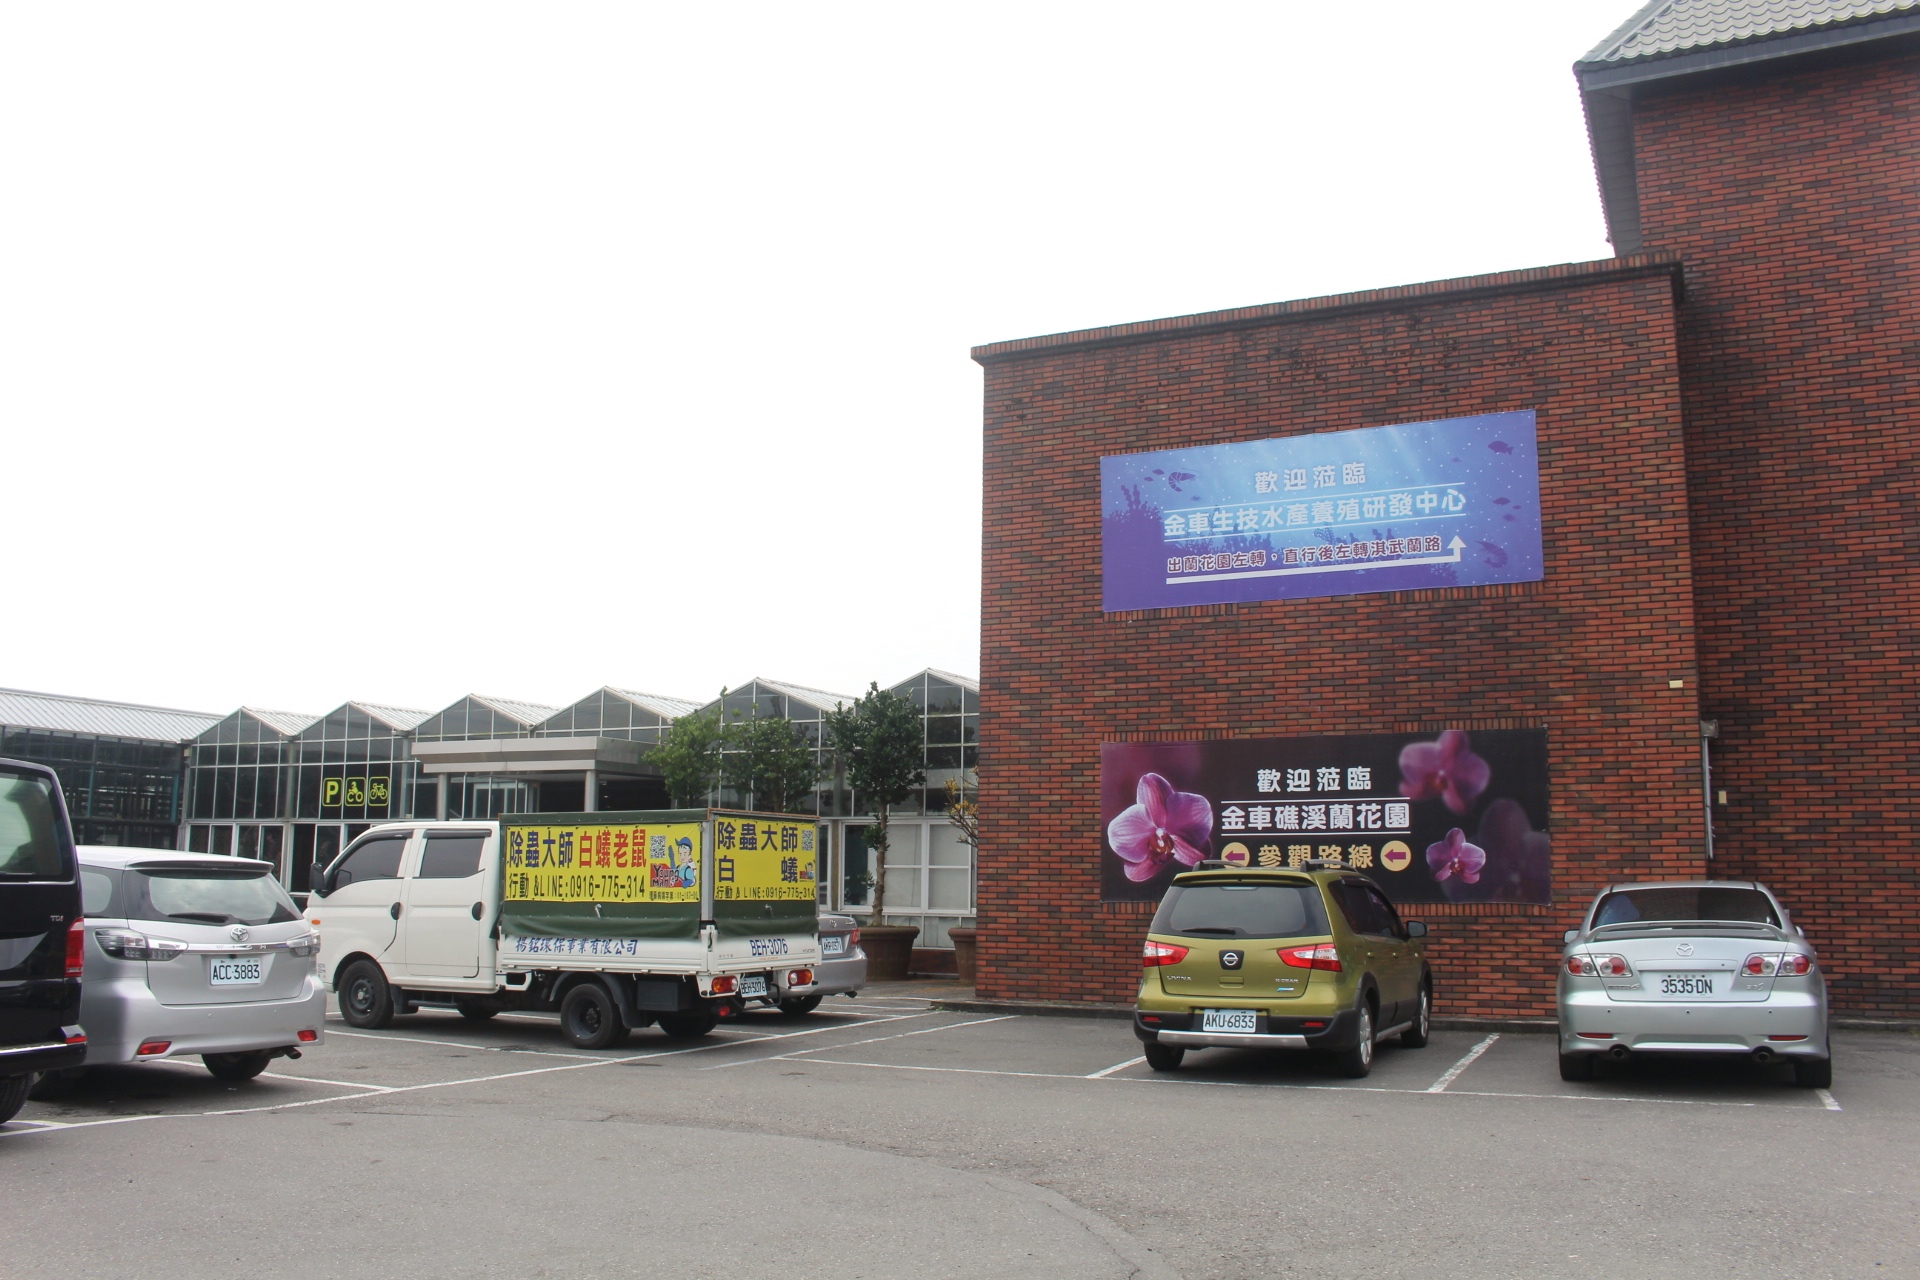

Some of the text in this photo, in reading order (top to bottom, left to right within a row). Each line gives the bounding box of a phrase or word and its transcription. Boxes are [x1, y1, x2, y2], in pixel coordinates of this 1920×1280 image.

[1254, 462, 1367, 494] 歡迎蒞臨
[1163, 489, 1466, 537] 金車生技水產養殖研發中心
[1256, 766, 1372, 793] 歡迎蒞臨
[1221, 802, 1410, 830] 金車礁溪蘭花園
[508, 828, 647, 869] 除蟲大師 白蟻老鼠
[717, 821, 798, 853] 除蟲大師
[718, 855, 799, 883] 白 蟻
[1257, 843, 1374, 869] 參觀路線
[508, 872, 530, 899] 行動
[716, 885, 733, 899] 行動
[515, 936, 639, 956] 楊銘環保事業有限公司
[749, 938, 789, 956] BEH-3076
[212, 963, 260, 980] ACC-3883
[740, 980, 766, 995] BEH-3076
[1661, 978, 1713, 994] 3535-DN
[1204, 1013, 1255, 1029] AKU-6833
